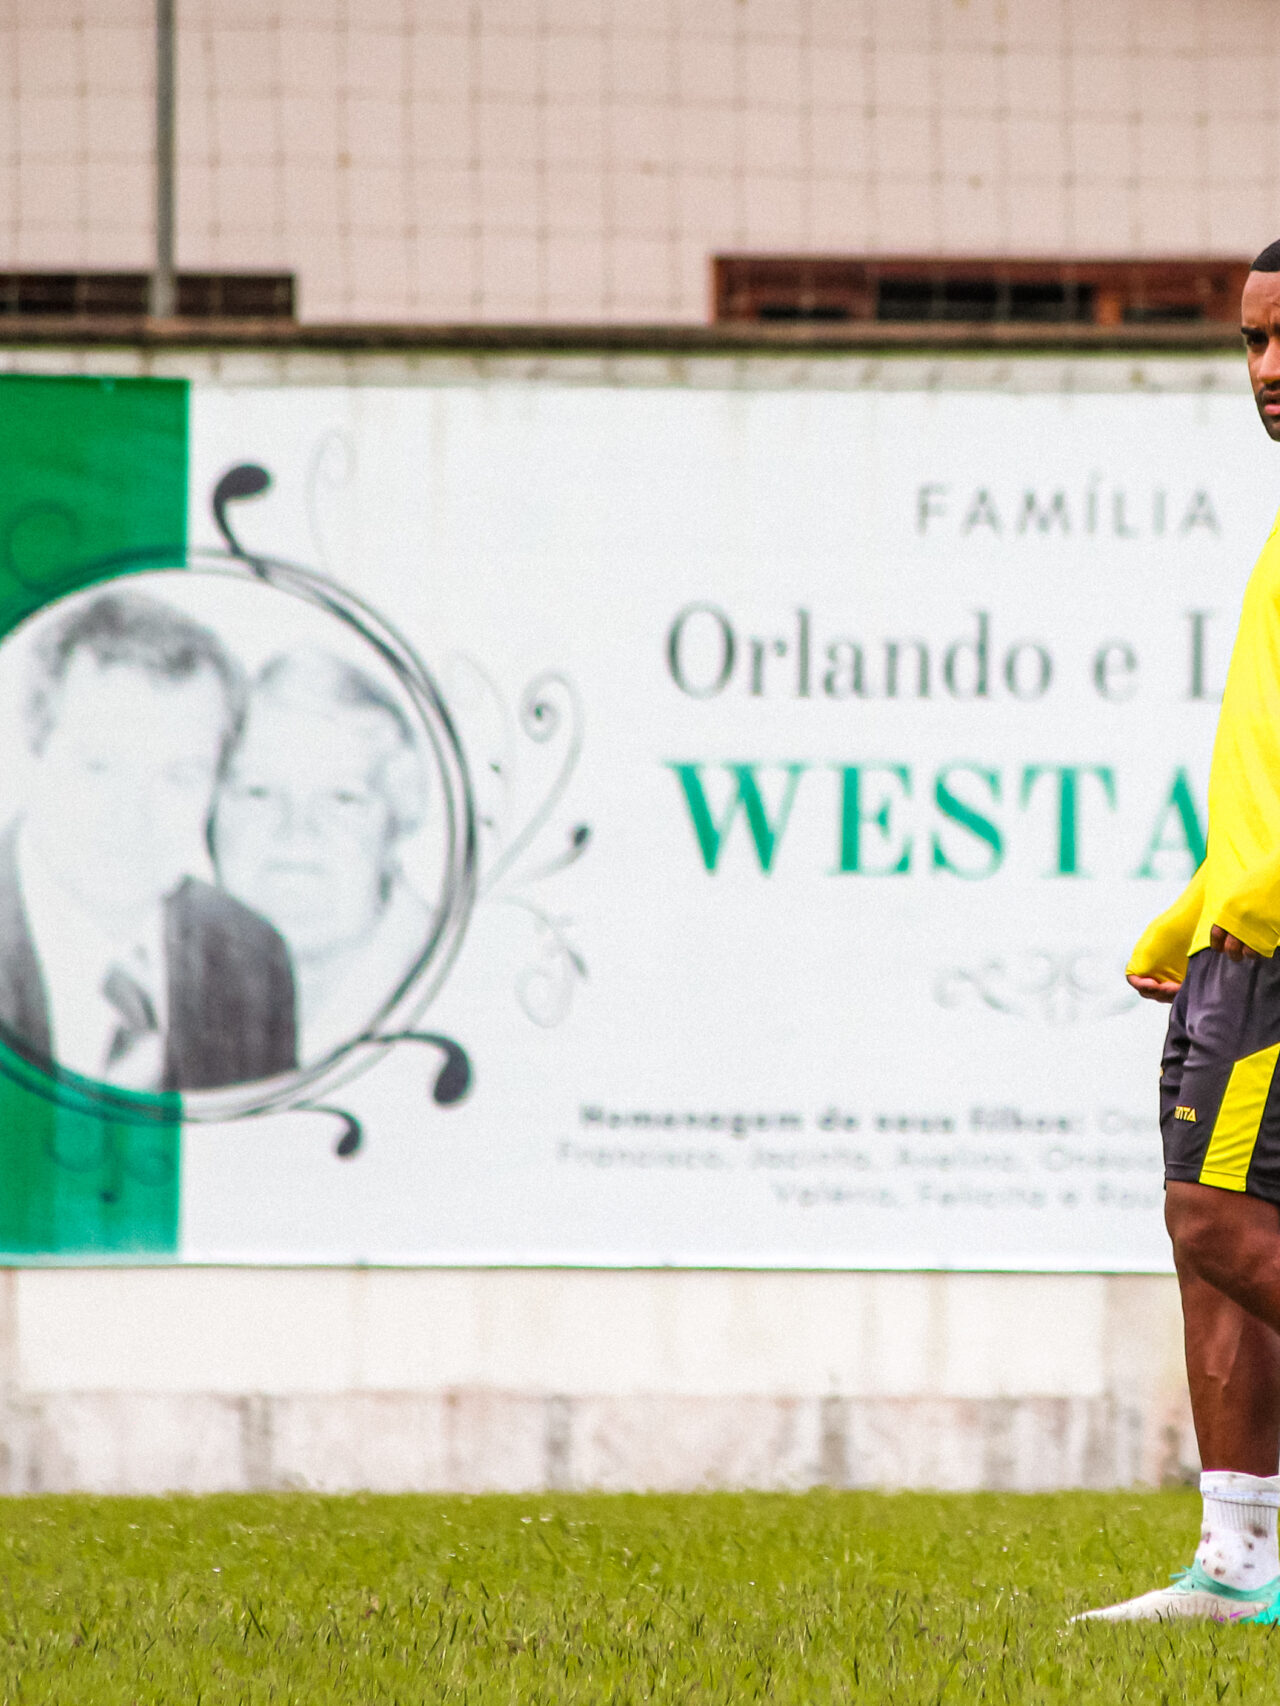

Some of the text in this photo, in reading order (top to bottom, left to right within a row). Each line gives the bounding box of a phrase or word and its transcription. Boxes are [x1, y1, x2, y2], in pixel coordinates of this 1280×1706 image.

[914, 471, 1222, 539] FAMÍLIA
[664, 601, 1056, 701] Orlando
[1091, 643, 1140, 700] e
